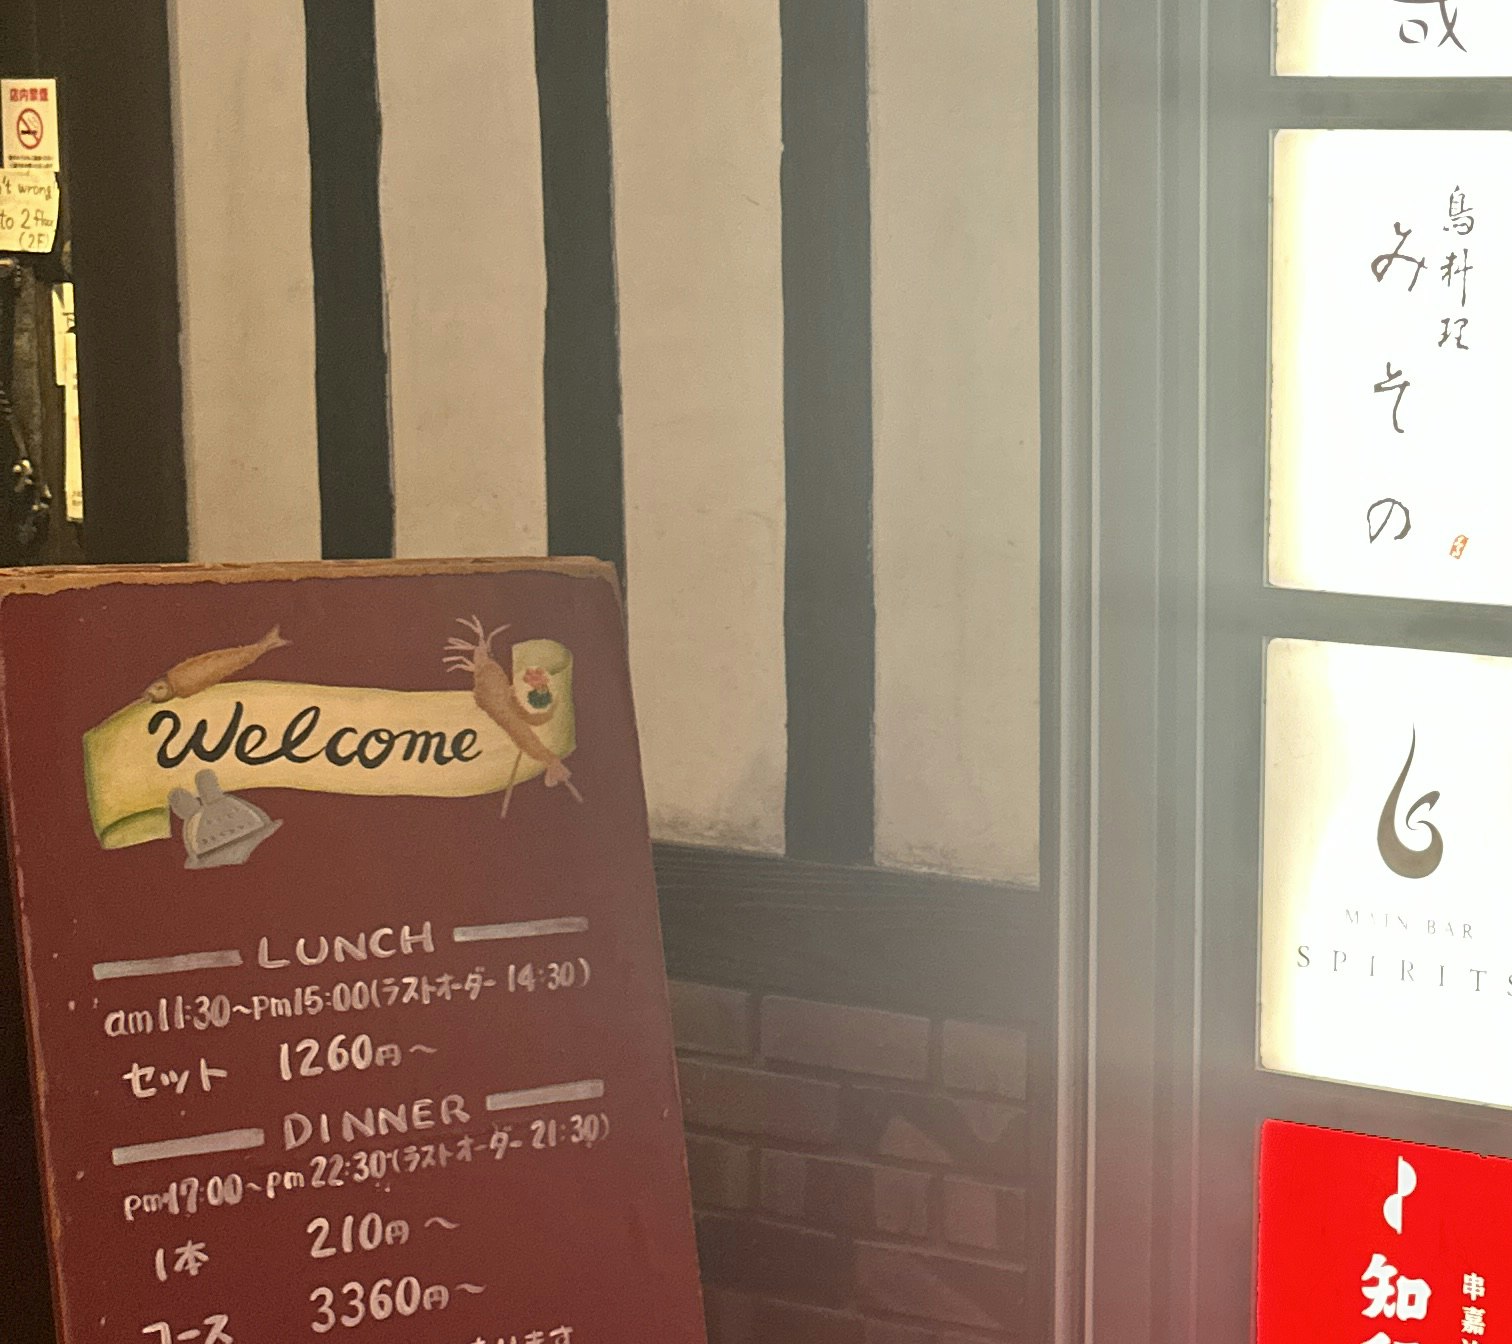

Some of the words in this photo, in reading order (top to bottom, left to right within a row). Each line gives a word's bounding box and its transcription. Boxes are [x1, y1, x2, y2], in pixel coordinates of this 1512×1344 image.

[1366, 220, 1429, 545] みその
[147, 700, 484, 770] Welcome
[257, 920, 436, 969] LUNCH
[1426, 918, 1474, 940] BAR
[121, 1057, 229, 1099] セット
[283, 1092, 472, 1152] DINNER
[154, 1239, 209, 1282] 1本
